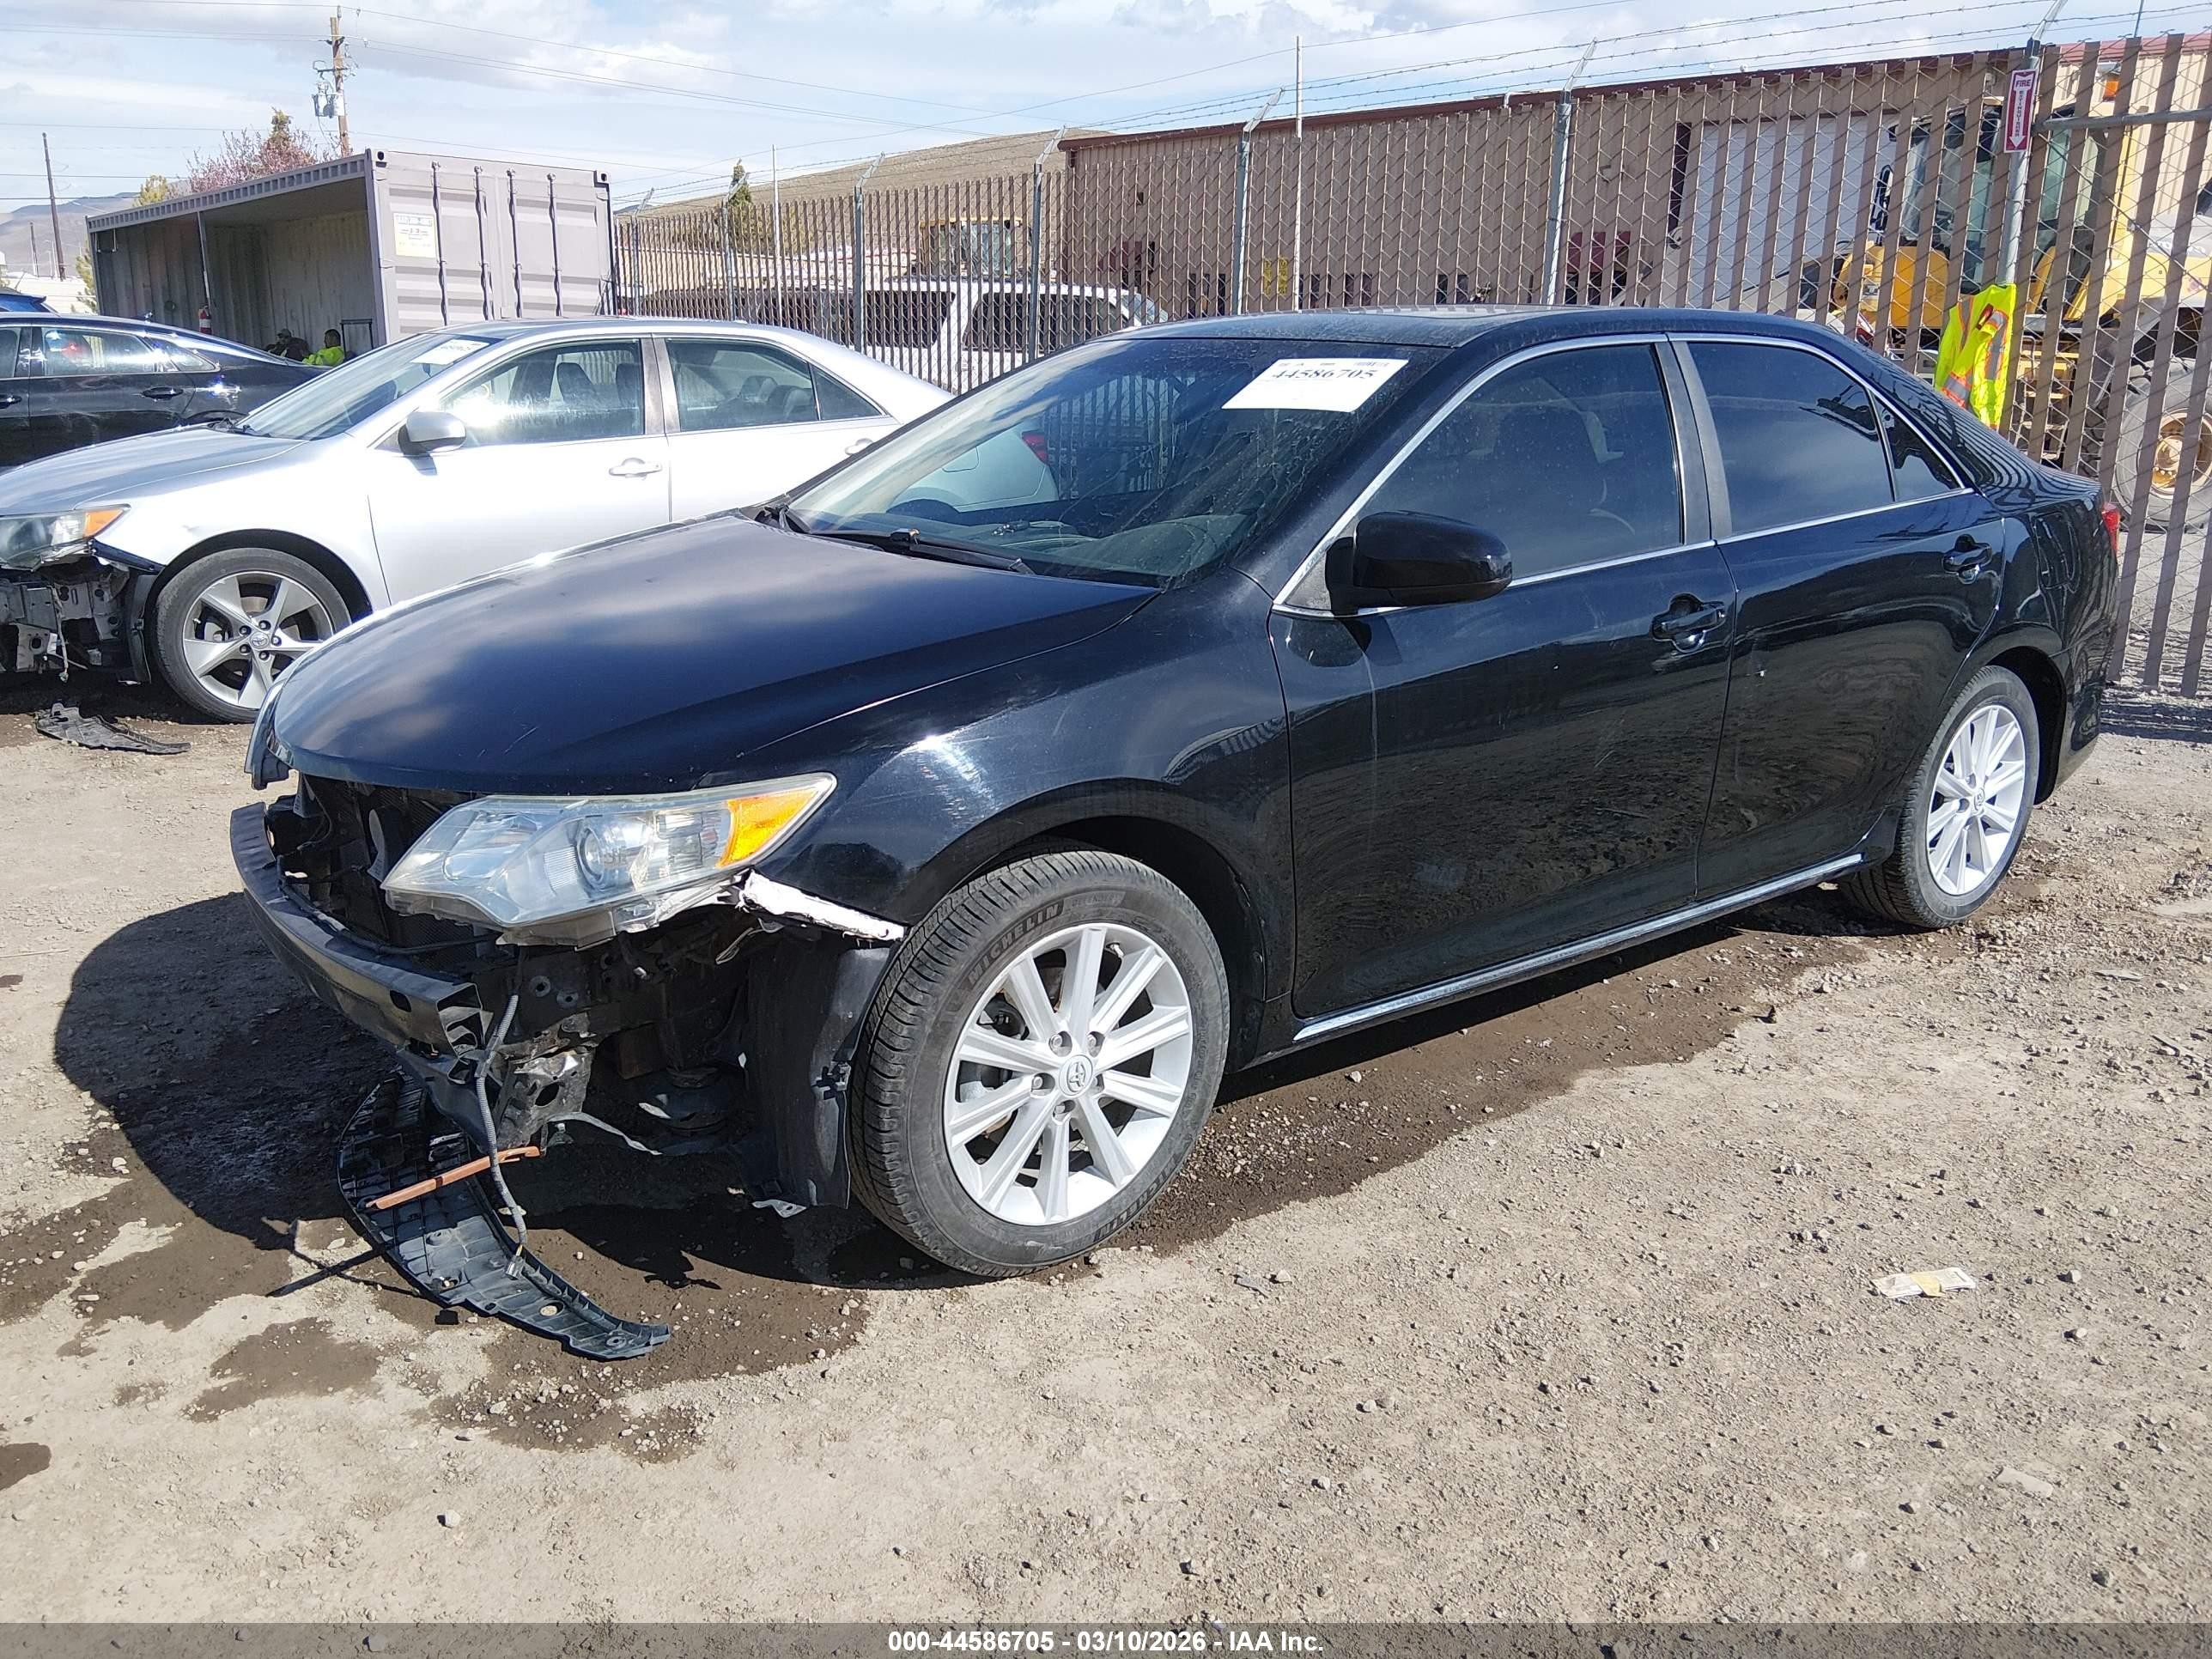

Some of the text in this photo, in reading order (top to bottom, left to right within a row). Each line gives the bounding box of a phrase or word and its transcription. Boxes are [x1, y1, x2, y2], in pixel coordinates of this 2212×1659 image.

[2015, 79, 2032, 88] FIRE
[1271, 368, 1378, 380] 44586705
[967, 902, 1060, 984] MICHELIN
